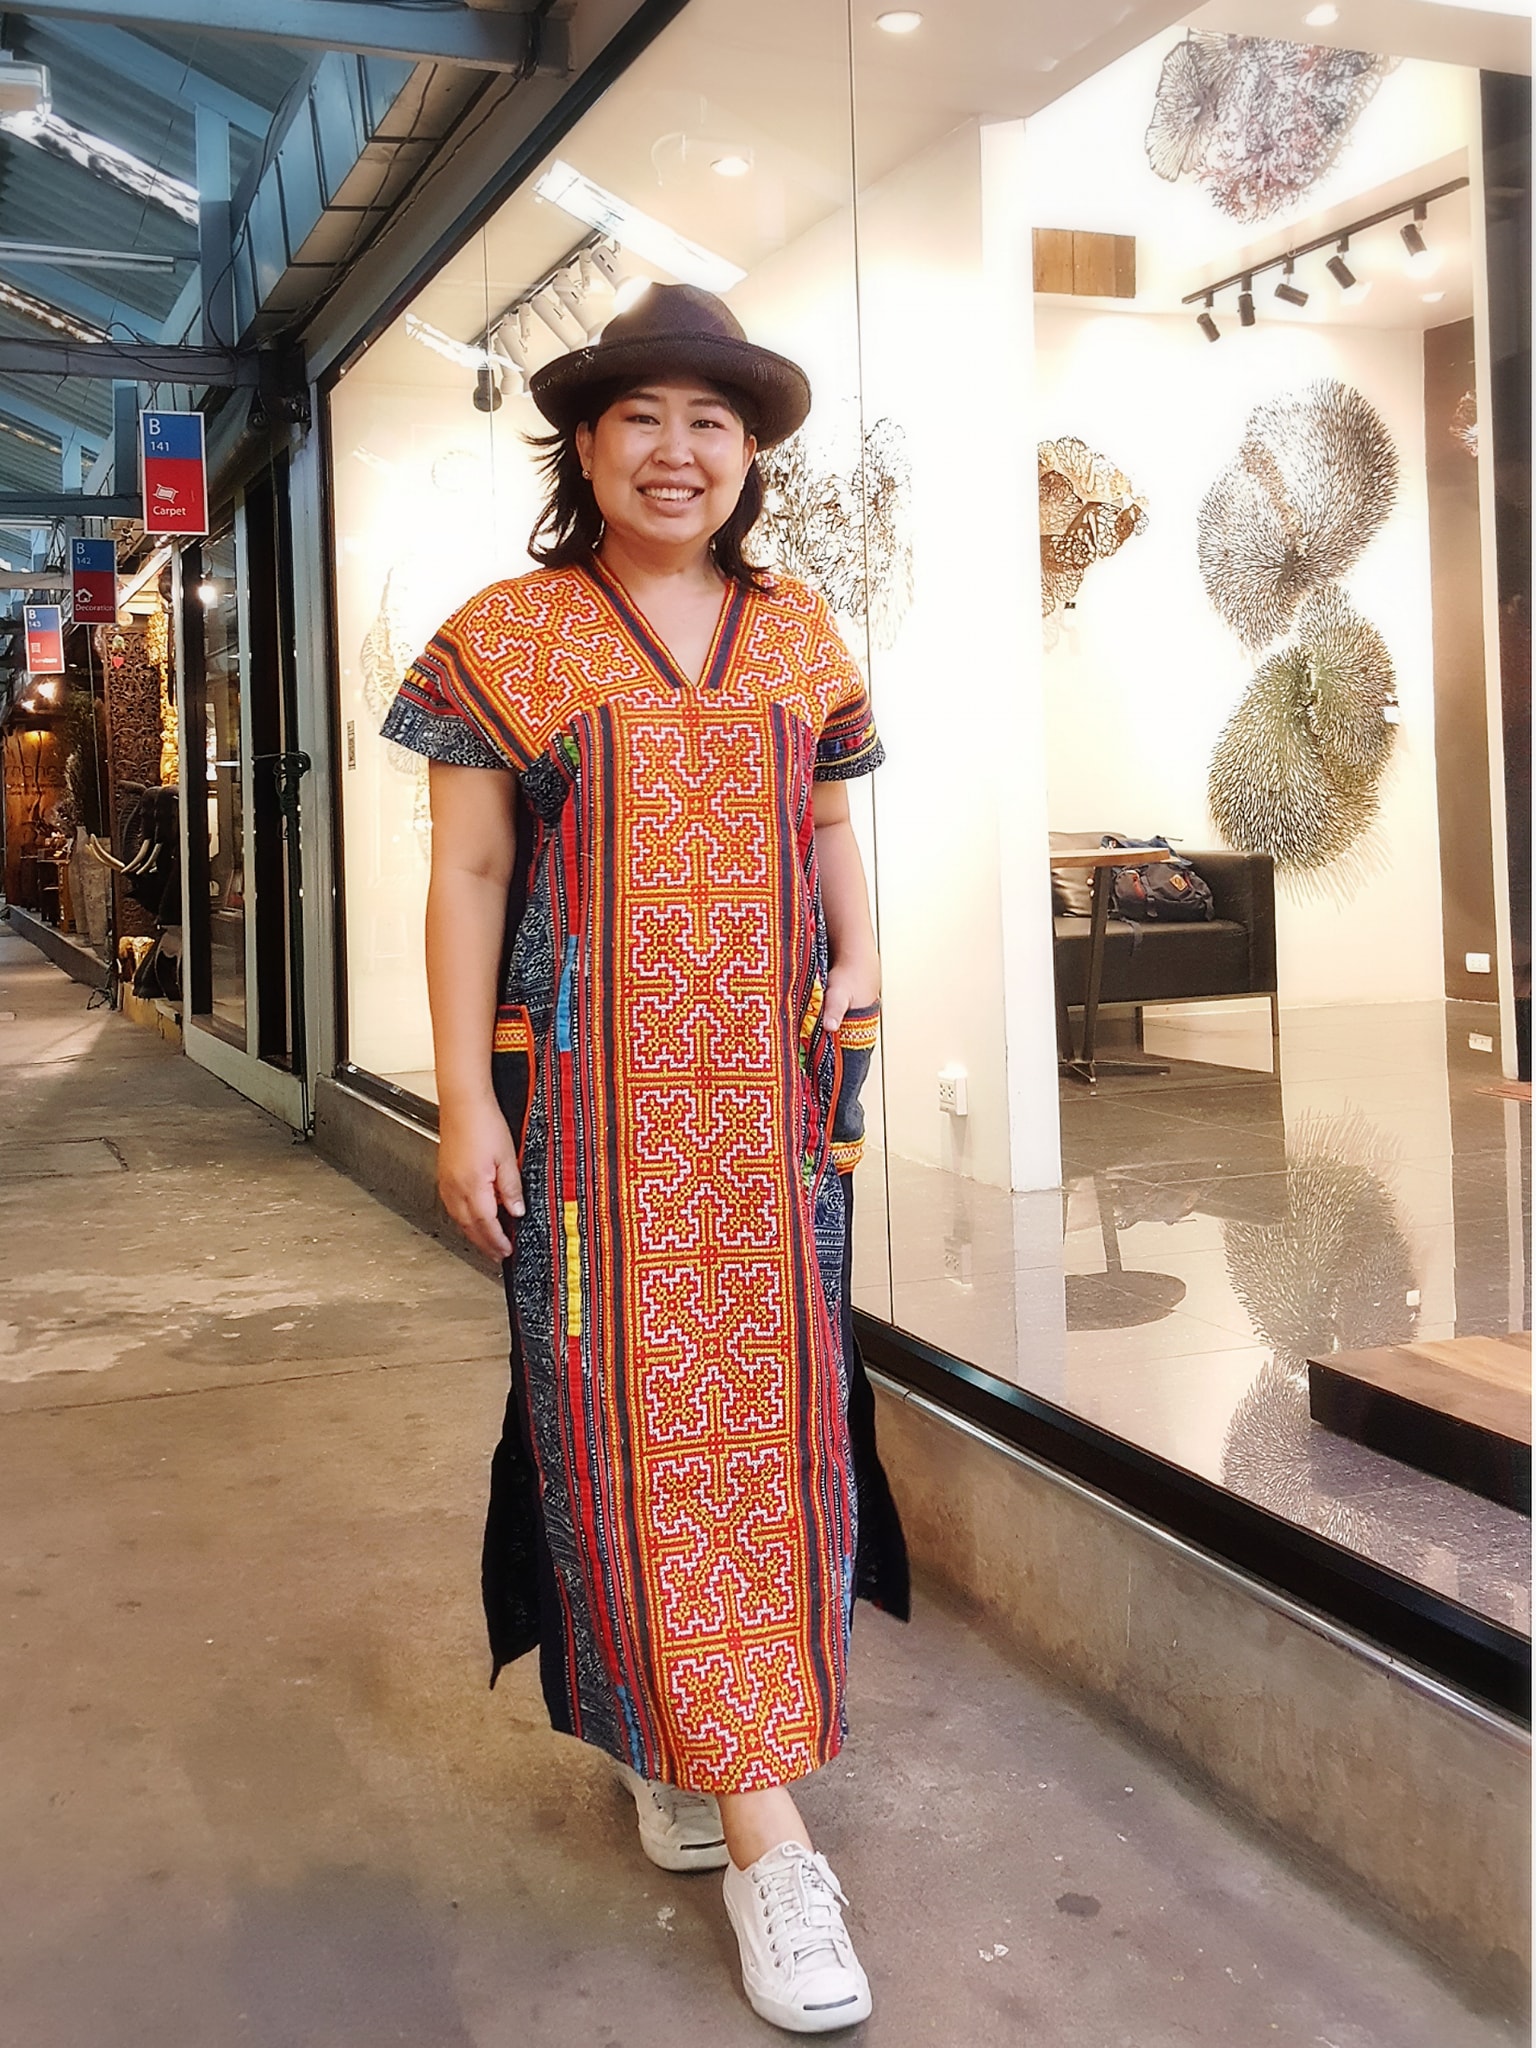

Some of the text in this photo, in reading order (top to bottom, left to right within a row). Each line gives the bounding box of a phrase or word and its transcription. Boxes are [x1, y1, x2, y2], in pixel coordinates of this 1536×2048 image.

[149, 418, 161, 435] B
[151, 441, 170, 452] 141
[153, 505, 187, 518] Carpet
[76, 542, 85, 555] B
[76, 557, 92, 565] 142
[75, 603, 114, 612] Decoration
[28, 609, 37, 620] B
